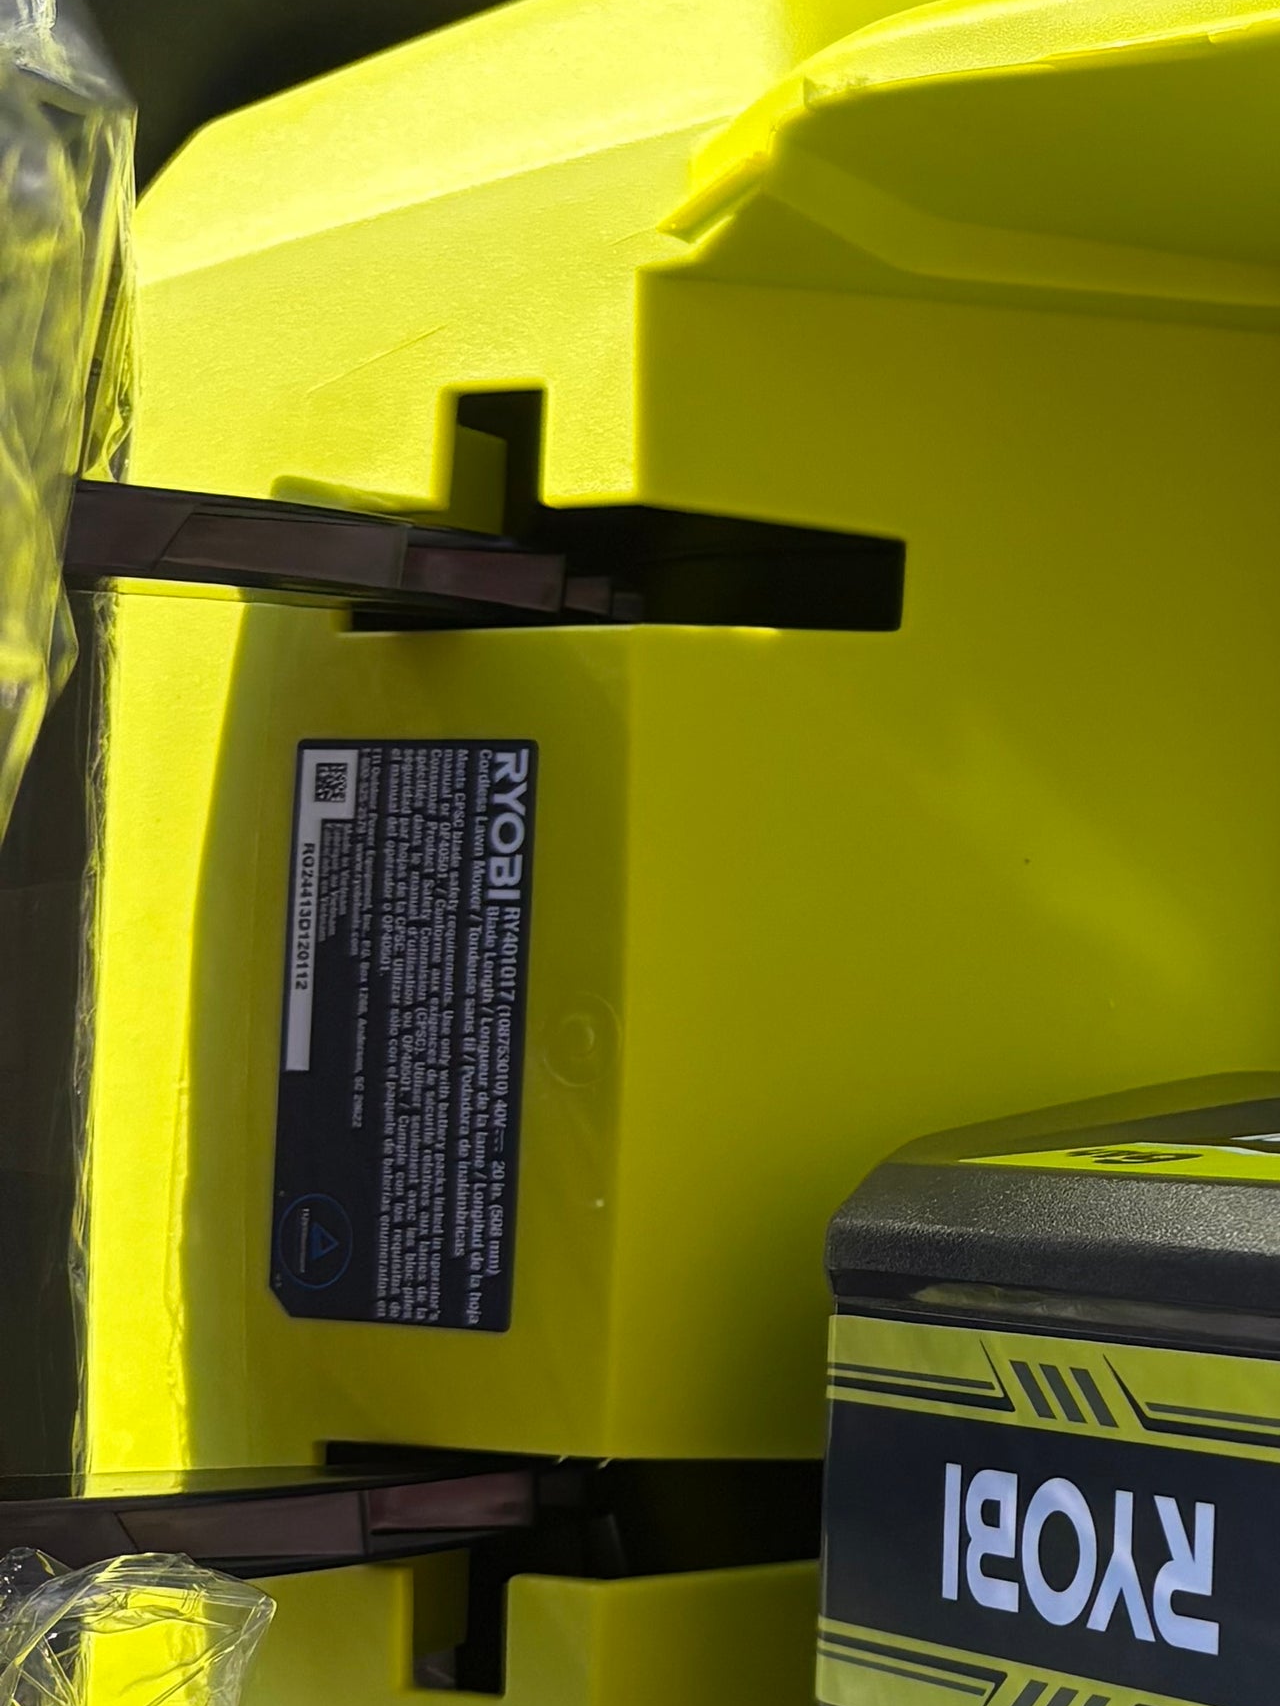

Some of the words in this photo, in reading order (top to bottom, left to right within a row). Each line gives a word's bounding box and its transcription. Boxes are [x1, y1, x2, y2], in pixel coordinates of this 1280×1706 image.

[486, 747, 528, 901] RYOBI
[497, 905, 520, 1001] RY401017
[942, 1463, 1219, 1656] RYOBI
